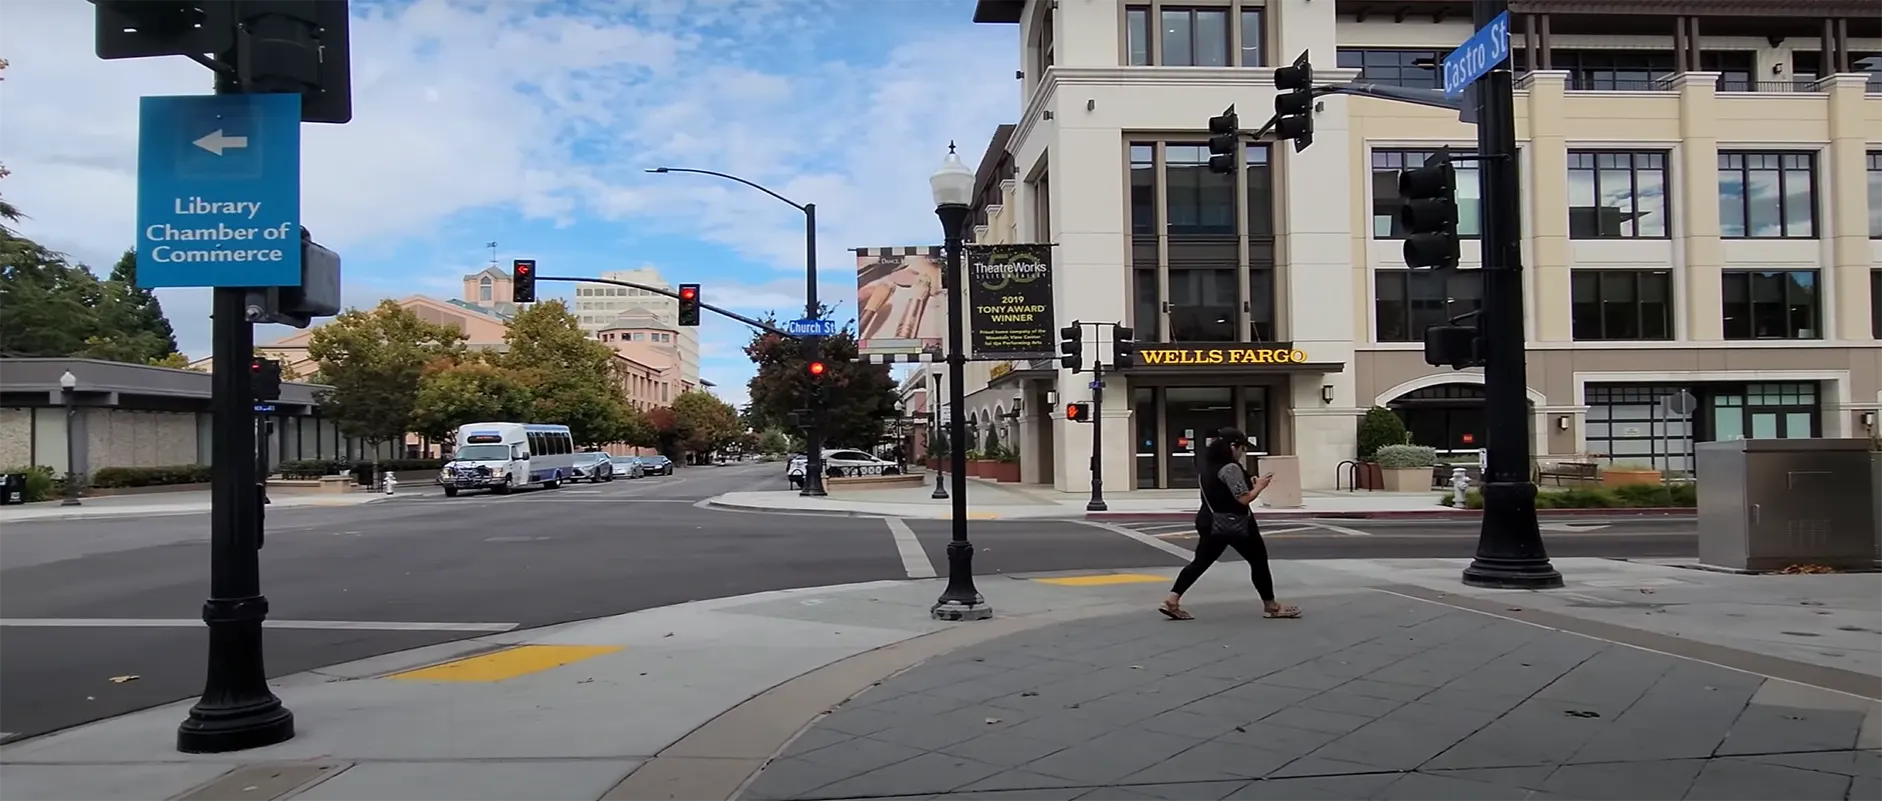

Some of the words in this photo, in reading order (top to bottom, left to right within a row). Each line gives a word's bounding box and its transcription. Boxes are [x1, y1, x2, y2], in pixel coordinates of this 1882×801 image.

[1444, 43, 1485, 93] Castro
[1491, 20, 1506, 59] St
[174, 196, 261, 220] Library
[146, 222, 259, 241] Chamber
[263, 221, 292, 240] of
[151, 245, 283, 263] Commerce
[973, 262, 1047, 274] TheatreWorks
[1001, 296, 1025, 304] 2019
[977, 306, 1006, 314] TONY
[1007, 305, 1045, 313] AWARD
[991, 314, 1033, 322] WINNER
[790, 321, 821, 334] Church
[824, 321, 835, 334] St
[1140, 349, 1223, 364] WELLS
[1228, 349, 1307, 364] FARGO
